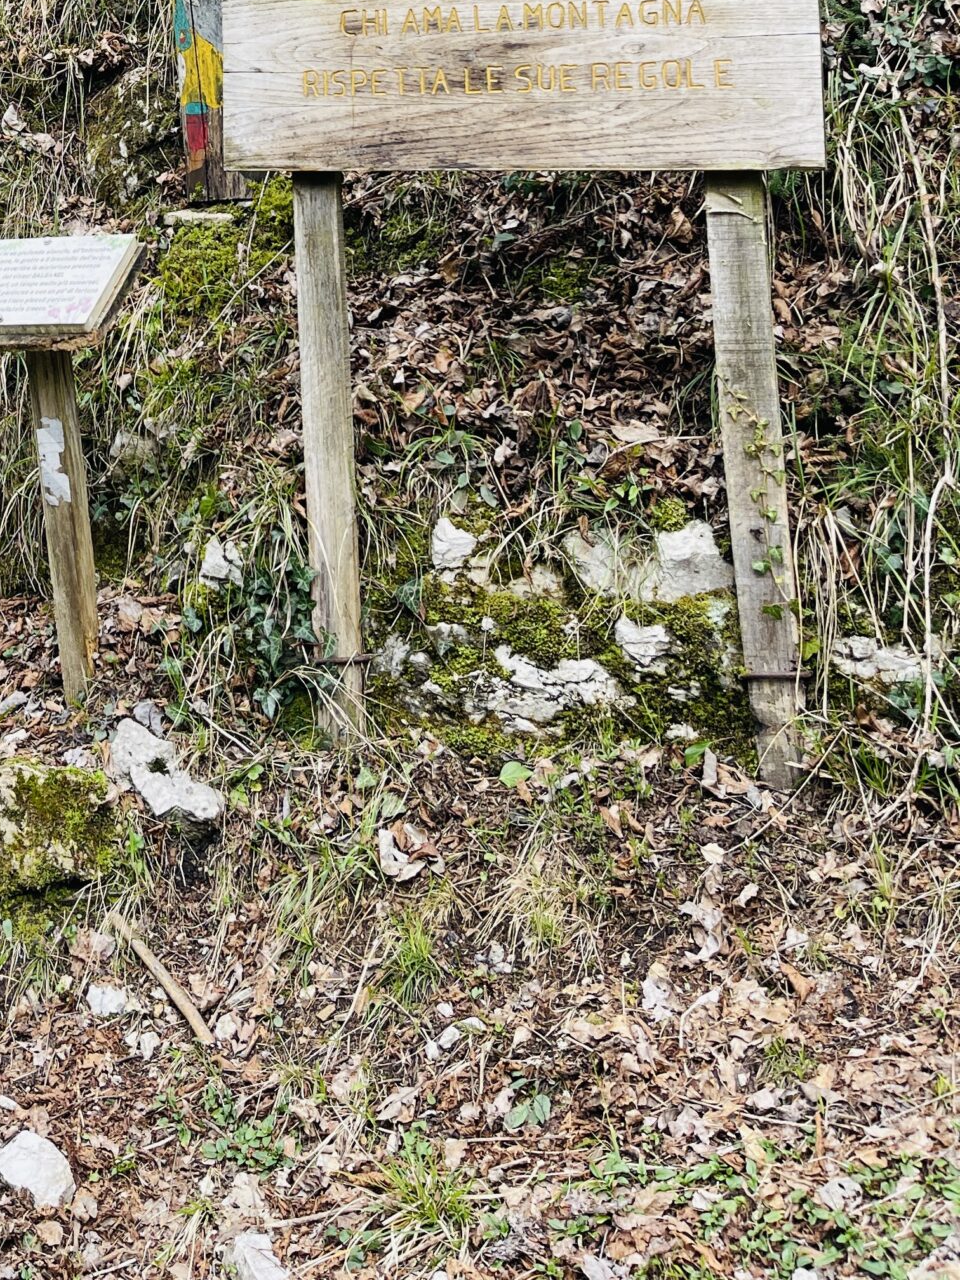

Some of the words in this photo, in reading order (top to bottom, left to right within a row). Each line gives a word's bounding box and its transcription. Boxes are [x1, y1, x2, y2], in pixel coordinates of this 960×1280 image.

[340, 9, 388, 37] CHI
[401, 5, 462, 35] AMA
[474, 4, 514, 32] LA
[302, 66, 450, 98] RISPETTA
[464, 66, 504, 95] LE
[514, 64, 578, 93] SUE
[591, 58, 734, 91] REGOLE
